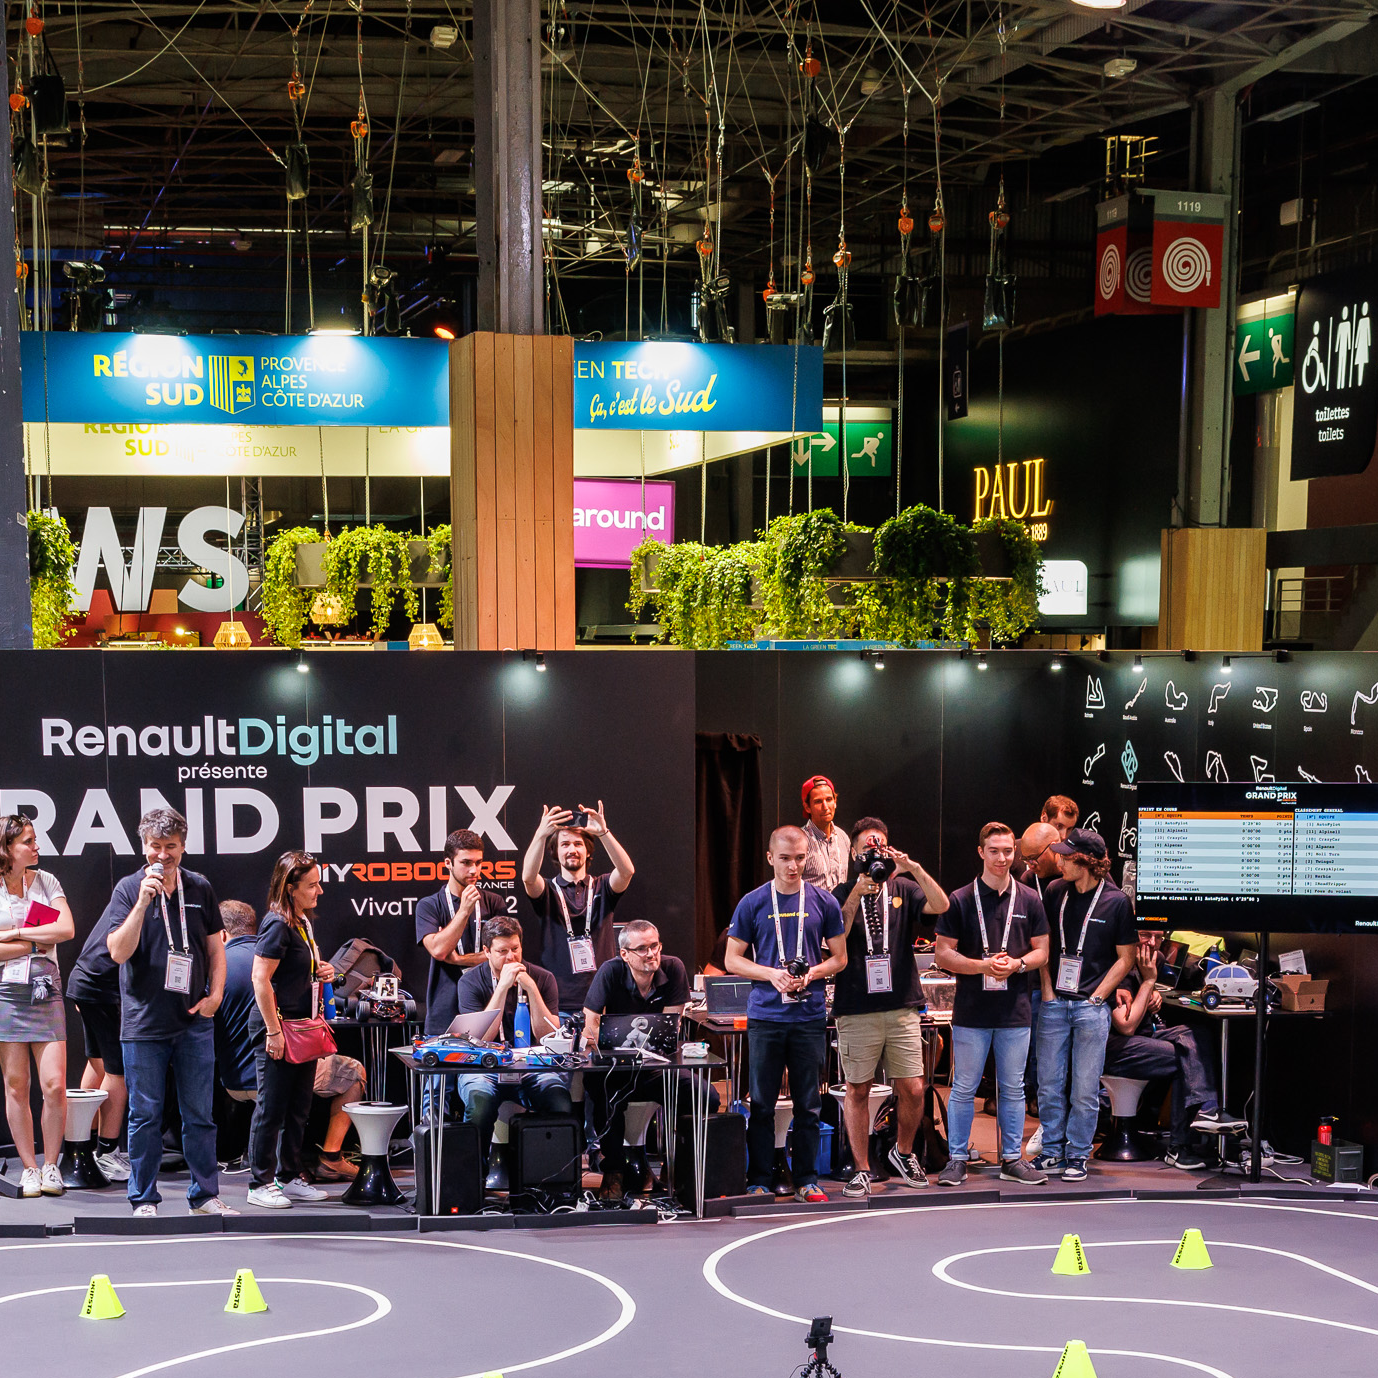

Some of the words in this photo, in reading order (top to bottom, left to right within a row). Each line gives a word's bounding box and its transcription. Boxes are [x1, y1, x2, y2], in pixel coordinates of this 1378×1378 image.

[1176, 200, 1202, 213] 1119
[93, 350, 204, 379] RÉGION
[260, 356, 347, 372] PROVENCE
[145, 382, 204, 406] SUD
[261, 374, 308, 389] ALPES
[261, 389, 305, 408] CÔTE
[307, 393, 365, 408] D'AZUR
[590, 393, 607, 423] Ça,
[609, 387, 640, 416] c'est
[639, 383, 658, 415] le
[658, 373, 718, 416] Sud
[1315, 405, 1350, 422] toilettes
[1317, 426, 1345, 443] toilets
[252, 445, 297, 457] D'AZUR
[972, 458, 1052, 523] PAUL
[1030, 522, 1048, 542] 1889
[40, 714, 398, 767] RenaultDigital
[177, 763, 268, 782] présente
[303, 783, 518, 853] PRIX
[475, 881, 515, 889] RANCE
